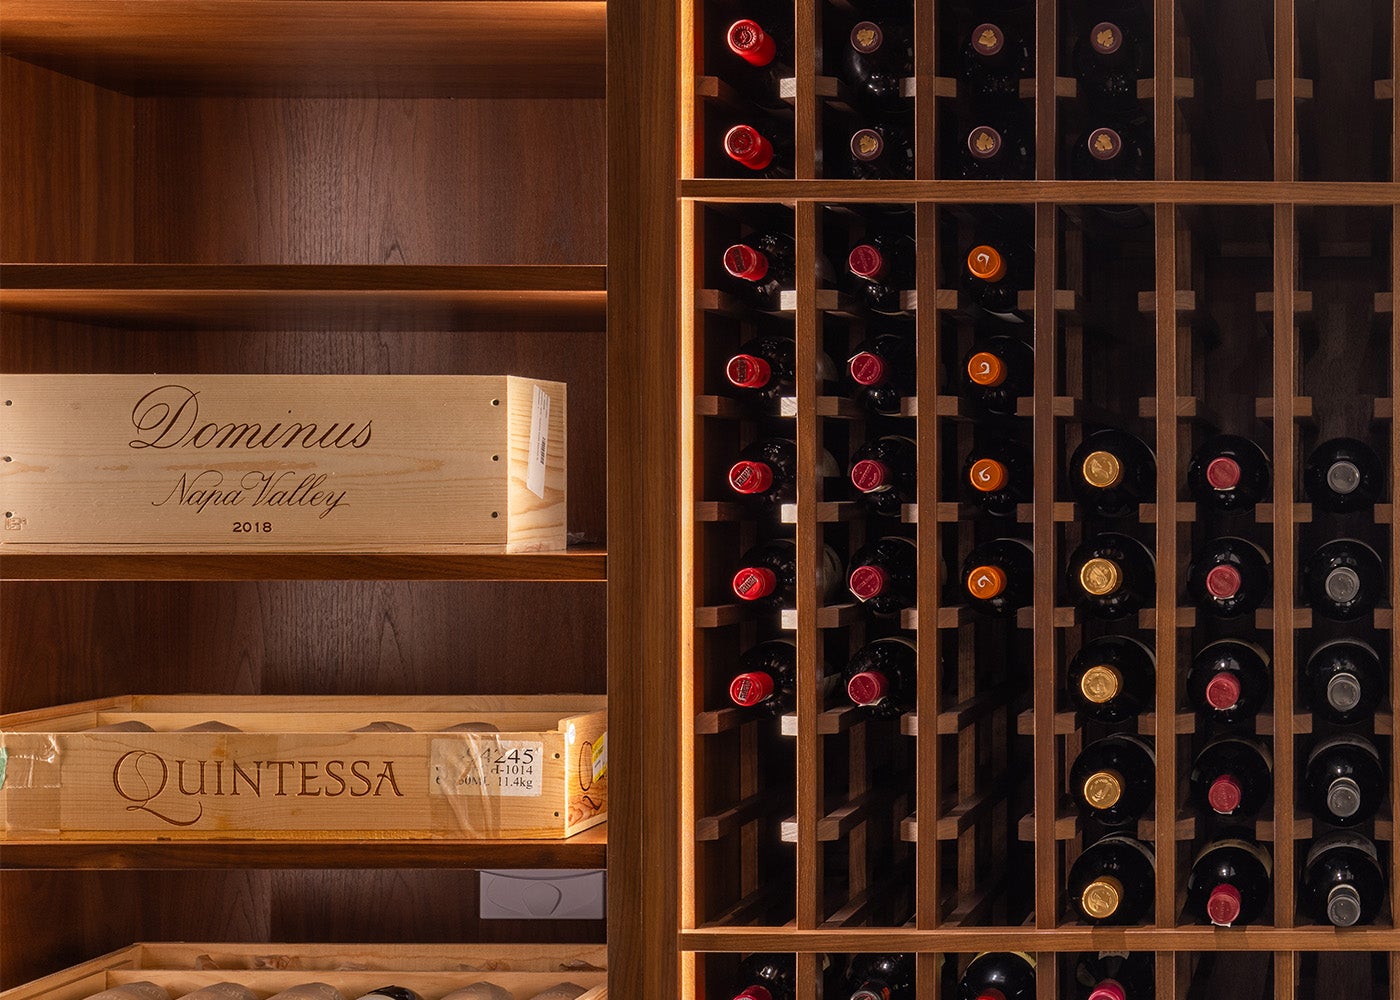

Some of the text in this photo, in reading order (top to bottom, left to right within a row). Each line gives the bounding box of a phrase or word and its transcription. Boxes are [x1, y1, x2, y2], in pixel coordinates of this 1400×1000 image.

[129, 385, 372, 449] Dominus
[152, 470, 350, 519] Napa Valley
[233, 522, 272, 532] 2018
[113, 750, 404, 826] QUINTESSA
[498, 777, 533, 789] 11.4kg
